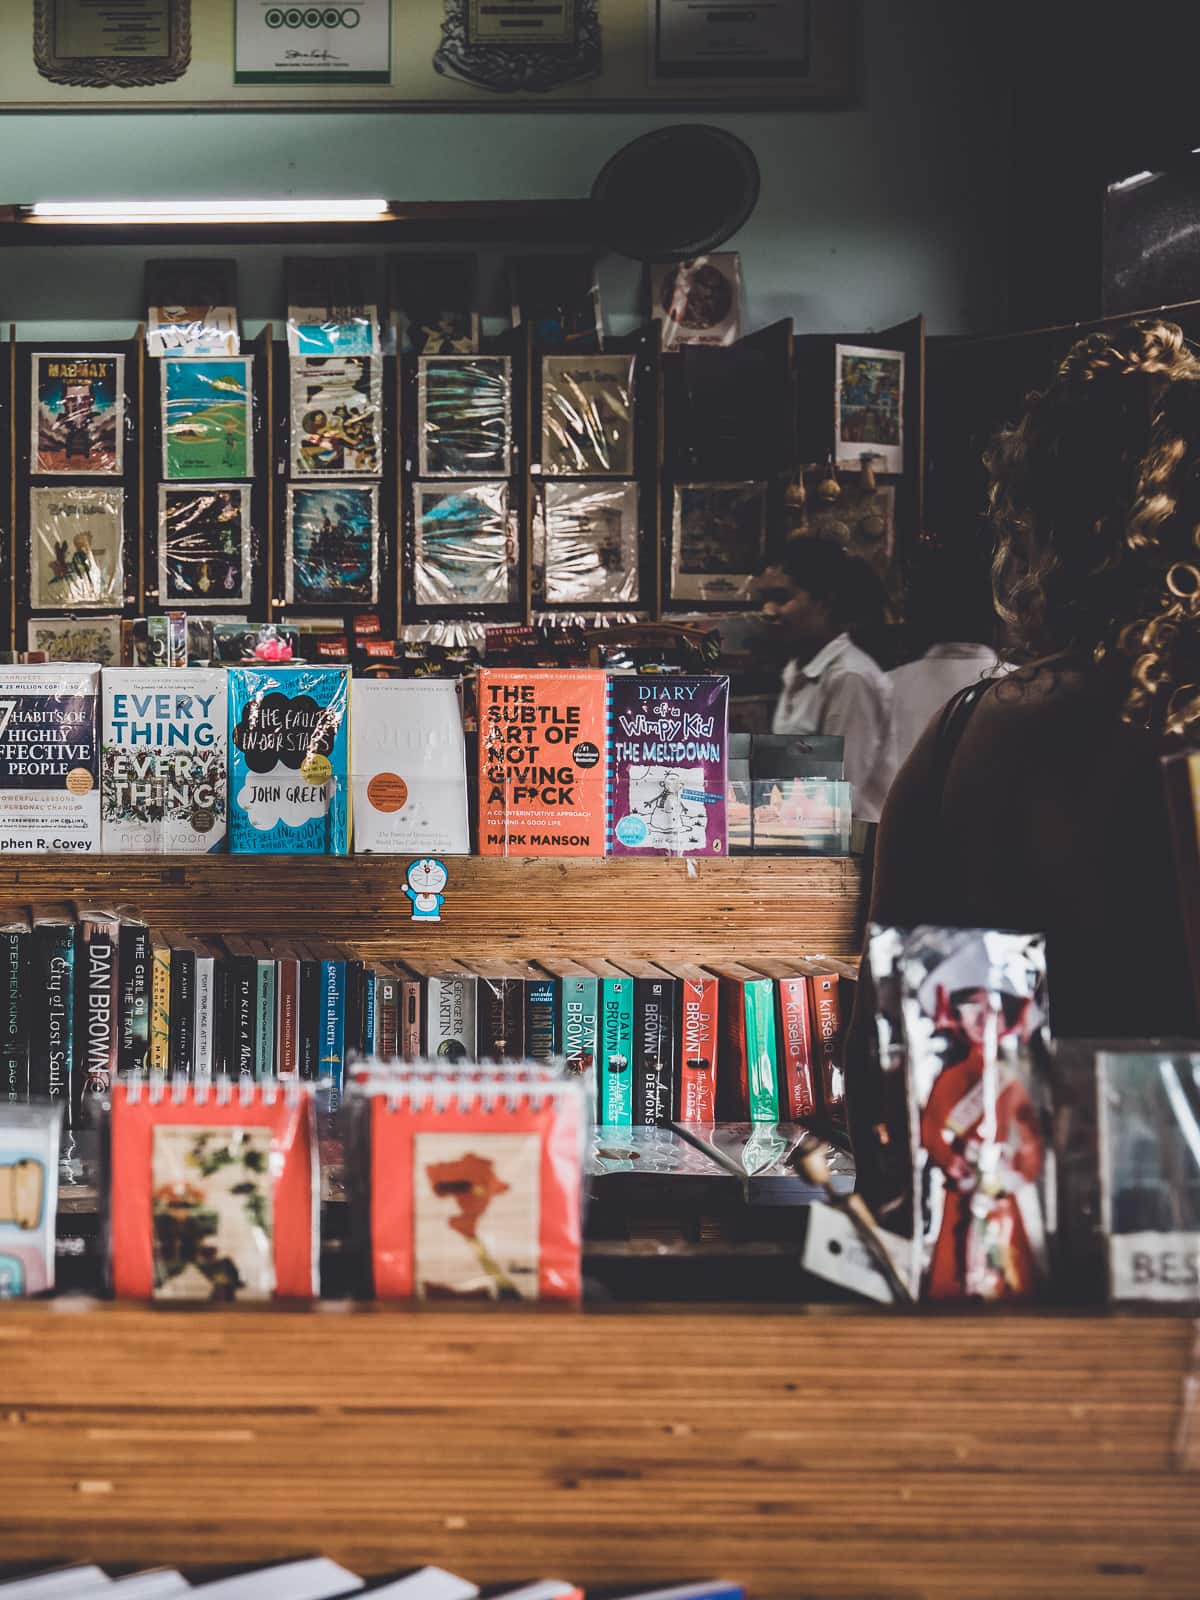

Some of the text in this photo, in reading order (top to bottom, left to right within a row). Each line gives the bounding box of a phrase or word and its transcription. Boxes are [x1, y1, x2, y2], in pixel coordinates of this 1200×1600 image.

[488, 685, 535, 703] THE
[639, 685, 698, 701] DIARY
[13, 711, 87, 723] HABITS OF
[114, 694, 217, 719] EVERY
[488, 705, 581, 724] SUBTLE
[653, 702, 680, 717] of a
[8, 729, 70, 742] HIGHLY
[112, 721, 215, 746] THING
[489, 726, 579, 745] ART OF
[619, 712, 715, 742] Wimpy Kid
[488, 745, 540, 764] NOT
[615, 741, 721, 764] THE MELTDOWN
[8, 762, 70, 775] PEOPLE
[113, 755, 216, 781] EVERY
[487, 766, 575, 784] GIVING
[116, 783, 216, 808] THING
[250, 785, 327, 804] JOHN GREEN
[488, 786, 506, 804] A
[36, 838, 50, 849] R.
[52, 838, 94, 850] Covey
[170, 835, 207, 847] yoon
[488, 834, 590, 846] MARK MANSON
[9, 935, 19, 1034] STEPHEN KING
[135, 935, 144, 1015] THE GIRL ON
[241, 981, 248, 994] TO
[88, 944, 111, 1072] DAN BROWN
[200, 995, 208, 1009] YOUR
[326, 966, 340, 1046] cecelia ahern
[440, 981, 452, 1036] MARTIN
[454, 981, 464, 1016] GEORGE
[47, 956, 65, 1096] City of Lost Souls
[124, 979, 133, 1049] THE TRAIN
[532, 1006, 552, 1029] DAN
[607, 1001, 618, 1051] BROWN
[620, 1012, 629, 1041] DAN
[819, 999, 835, 1054] kinsella
[201, 1031, 207, 1039] AT
[241, 1031, 248, 1039] A
[567, 1002, 582, 1061] BROWN
[583, 1015, 595, 1048] DAN
[644, 1003, 658, 1054] BROWN
[685, 1002, 699, 1052] BROWN
[700, 1013, 710, 1042] DAN
[786, 1002, 801, 1056] kinsella
[8, 1060, 17, 1084] BAG
[608, 1073, 616, 1121] FORTRESS
[644, 1074, 655, 1125] DEMONS
[793, 1084, 802, 1102] Your
